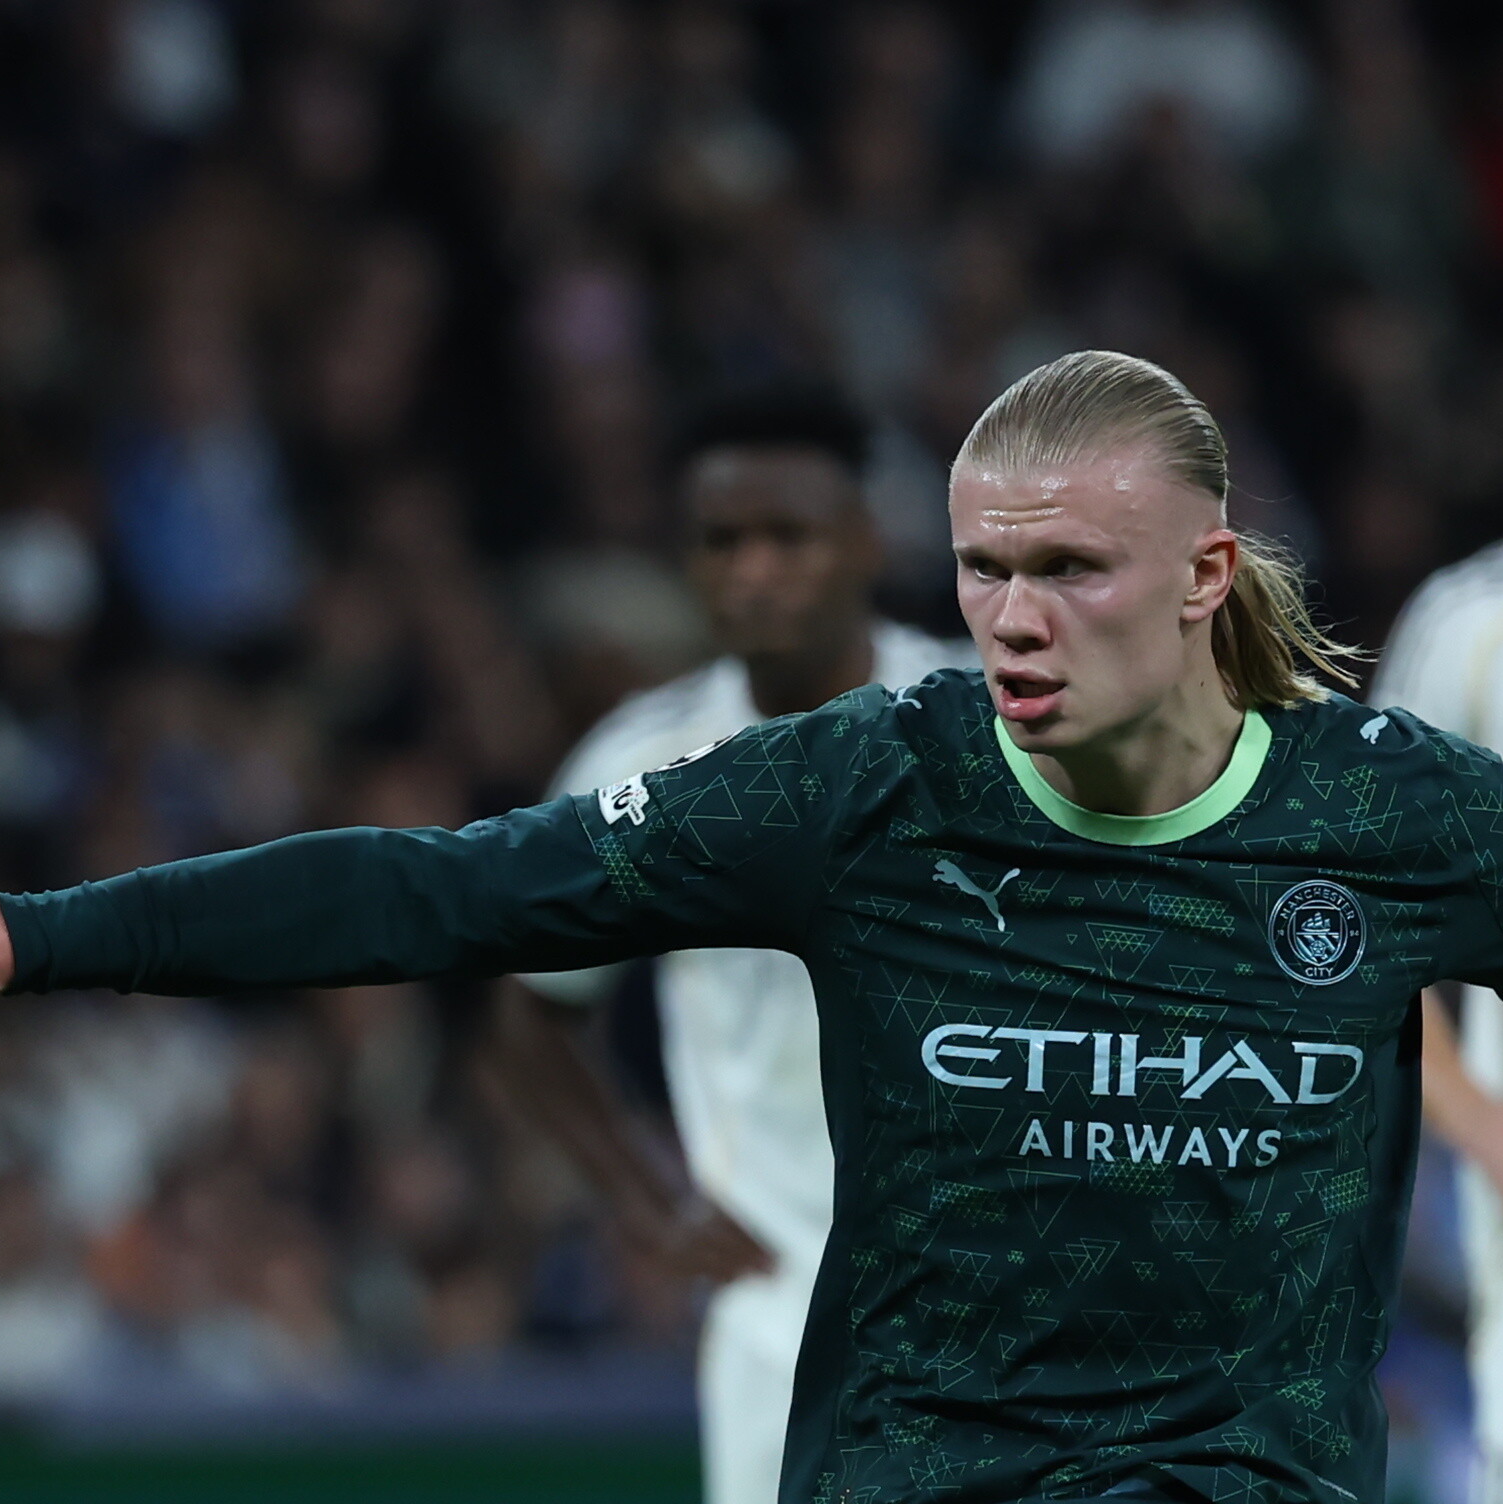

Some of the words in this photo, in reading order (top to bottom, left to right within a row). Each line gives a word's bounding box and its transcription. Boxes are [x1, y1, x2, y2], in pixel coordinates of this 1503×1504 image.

[1280, 887, 1355, 920] MANCHESTER
[1305, 967, 1334, 977] CITY
[921, 1023, 1364, 1105] ETIHAD
[1019, 1118, 1282, 1168] AIRWAYS
